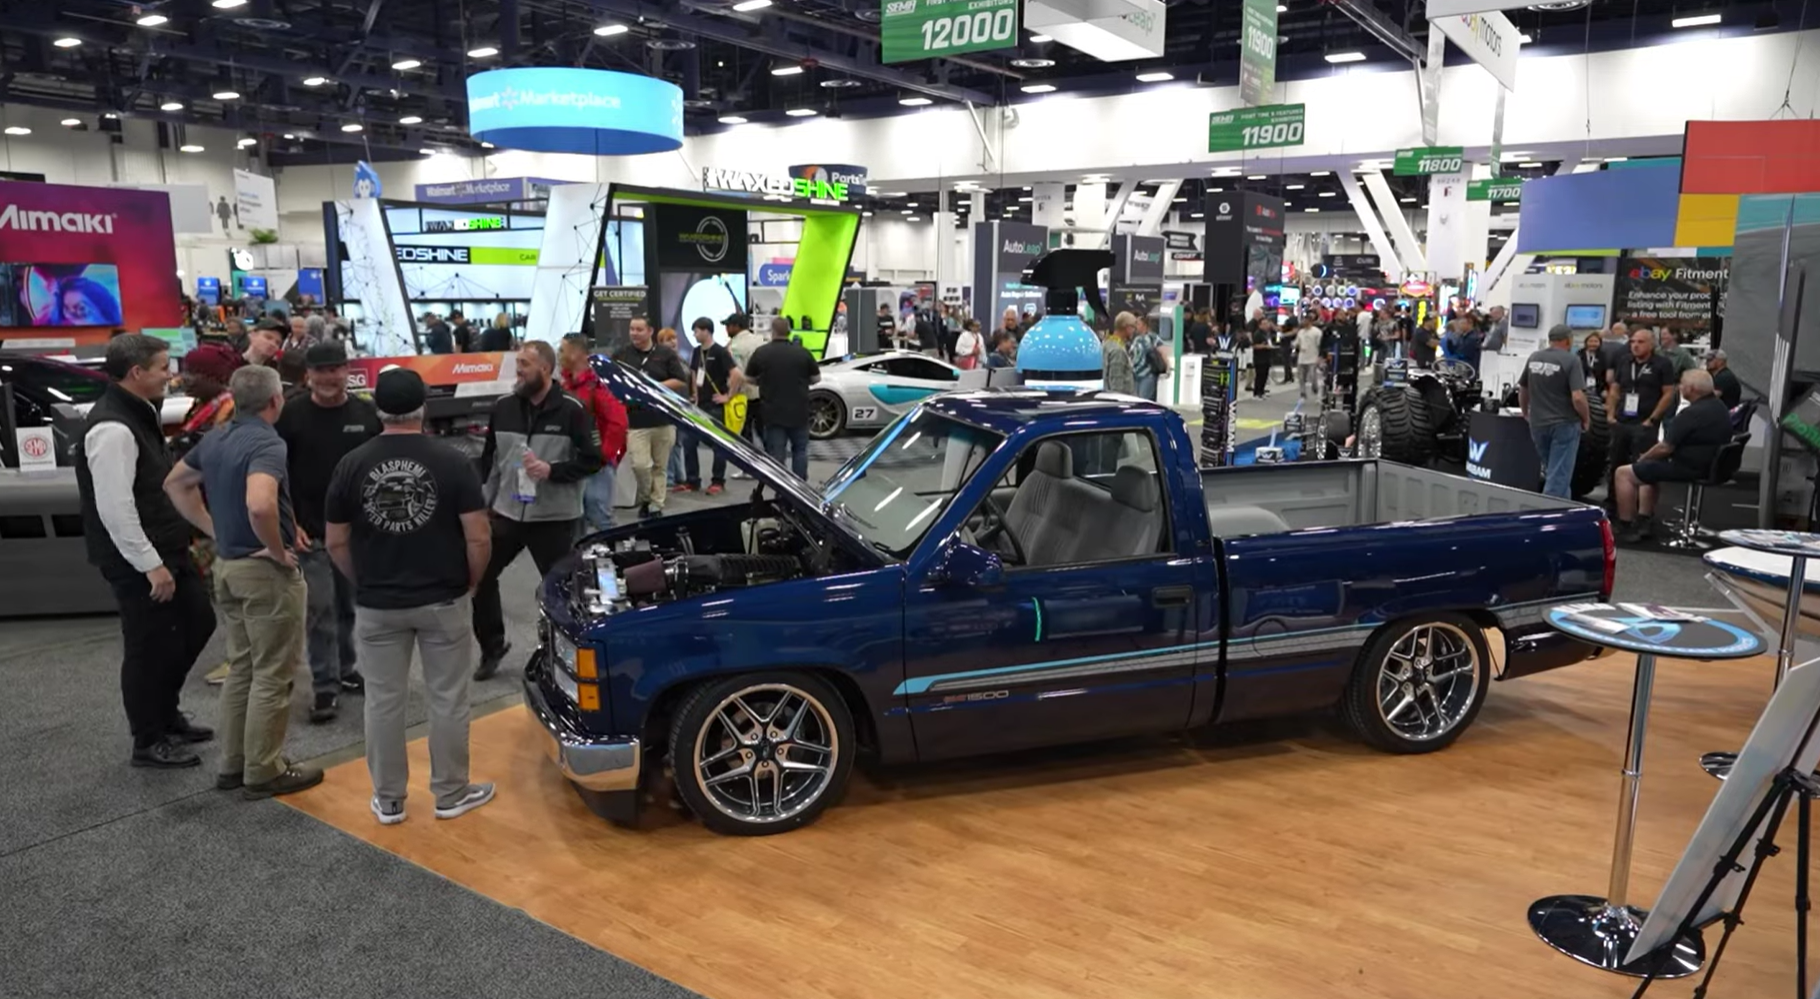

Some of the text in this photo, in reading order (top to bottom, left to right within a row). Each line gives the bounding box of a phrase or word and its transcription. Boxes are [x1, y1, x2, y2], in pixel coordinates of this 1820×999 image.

[921, 8, 1014, 51] 12000
[1248, 25, 1274, 60] 11900
[520, 88, 621, 110] Marketplace
[1242, 122, 1304, 146] 11900
[1417, 158, 1462, 173] 11800
[425, 181, 511, 198] Walmart Marketplace
[1487, 187, 1521, 199] 11700
[0, 203, 114, 235] Mimaki
[1003, 239, 1042, 256] AutoLeap
[1629, 266, 1730, 282] ebay Fitment
[1628, 291, 1667, 300] Enhance
[1668, 292, 1689, 301] your
[1627, 301, 1711, 310] listing with Fitment
[1659, 311, 1677, 319] tool
[855, 408, 875, 419] 27
[383, 520, 414, 532] PARTS
[968, 689, 1009, 701] 1500
